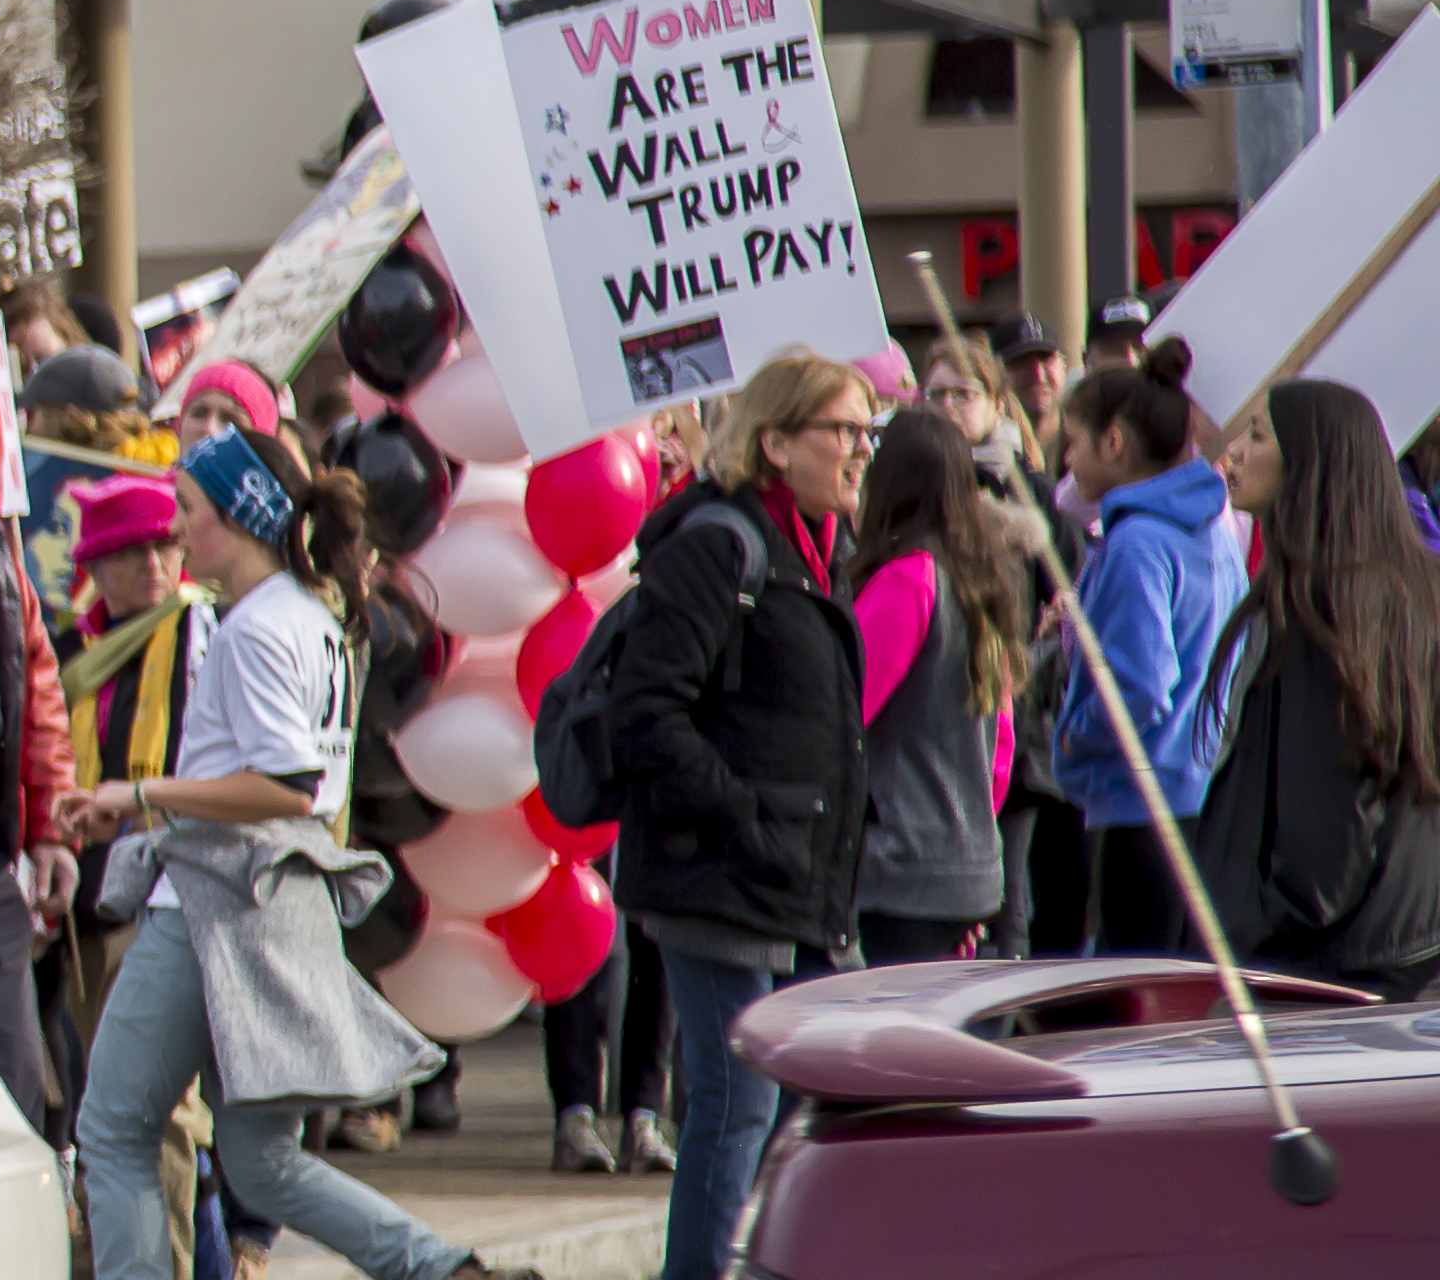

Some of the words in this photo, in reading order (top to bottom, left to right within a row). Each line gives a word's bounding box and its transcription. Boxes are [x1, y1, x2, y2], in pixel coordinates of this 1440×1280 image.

[608, 66, 709, 132] ARE
[721, 36, 815, 96] THE
[587, 119, 747, 201] WALL
[626, 158, 802, 248] TRUMP
[602, 253, 739, 327] WILL
[743, 216, 858, 287] PAY!
